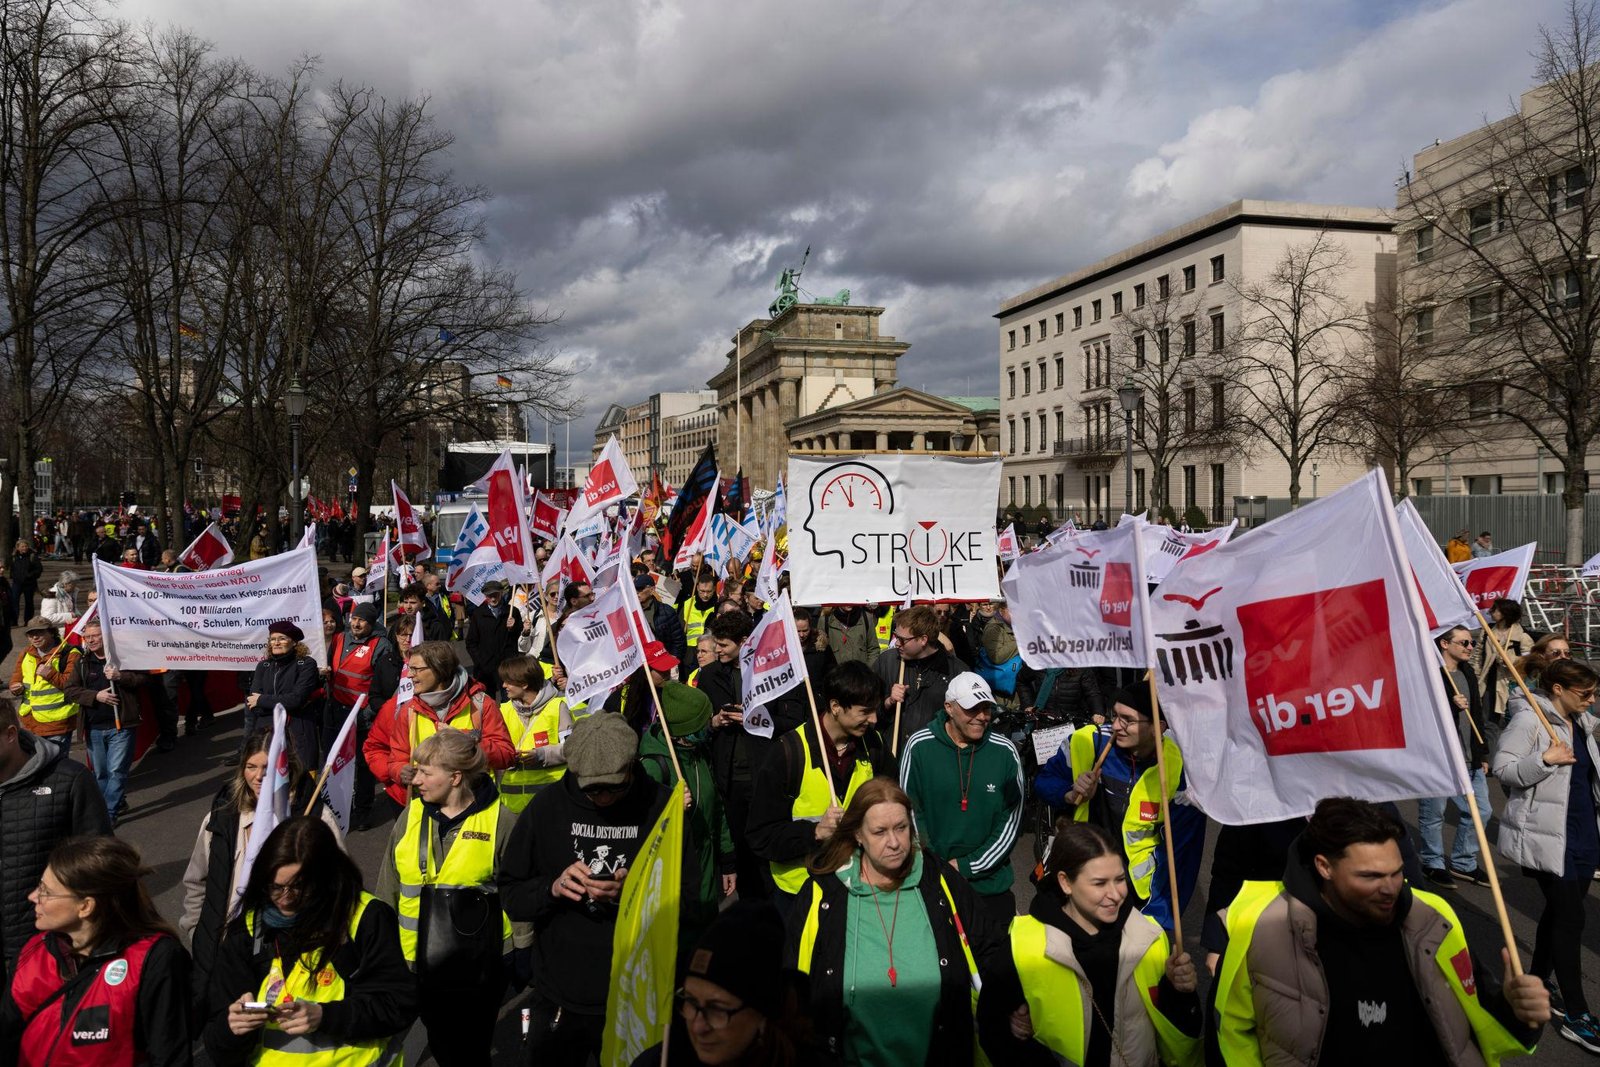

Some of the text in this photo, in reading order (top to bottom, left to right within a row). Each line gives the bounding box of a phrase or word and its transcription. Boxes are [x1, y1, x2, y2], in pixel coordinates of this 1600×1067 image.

[851, 532, 983, 564] STRIKE
[172, 581, 195, 590] Putin
[205, 579, 228, 588] noch
[230, 574, 261, 586] NATO!
[892, 564, 963, 596] UNIT
[107, 589, 128, 598] NEIN
[220, 592, 237, 600] den
[239, 584, 307, 598] Kriegshaushalt!
[180, 605, 242, 615] 100 Milliarden
[110, 616, 126, 626] für
[203, 619, 243, 629] Schulen,
[147, 640, 268, 650] Für unabhängige Arbeitnehmerpo
[165, 654, 270, 663] www.arbeitnehmerpolitik.d
[571, 822, 639, 839] SOCIAL DISTORTION
[73, 1028, 109, 1040] ver.di
